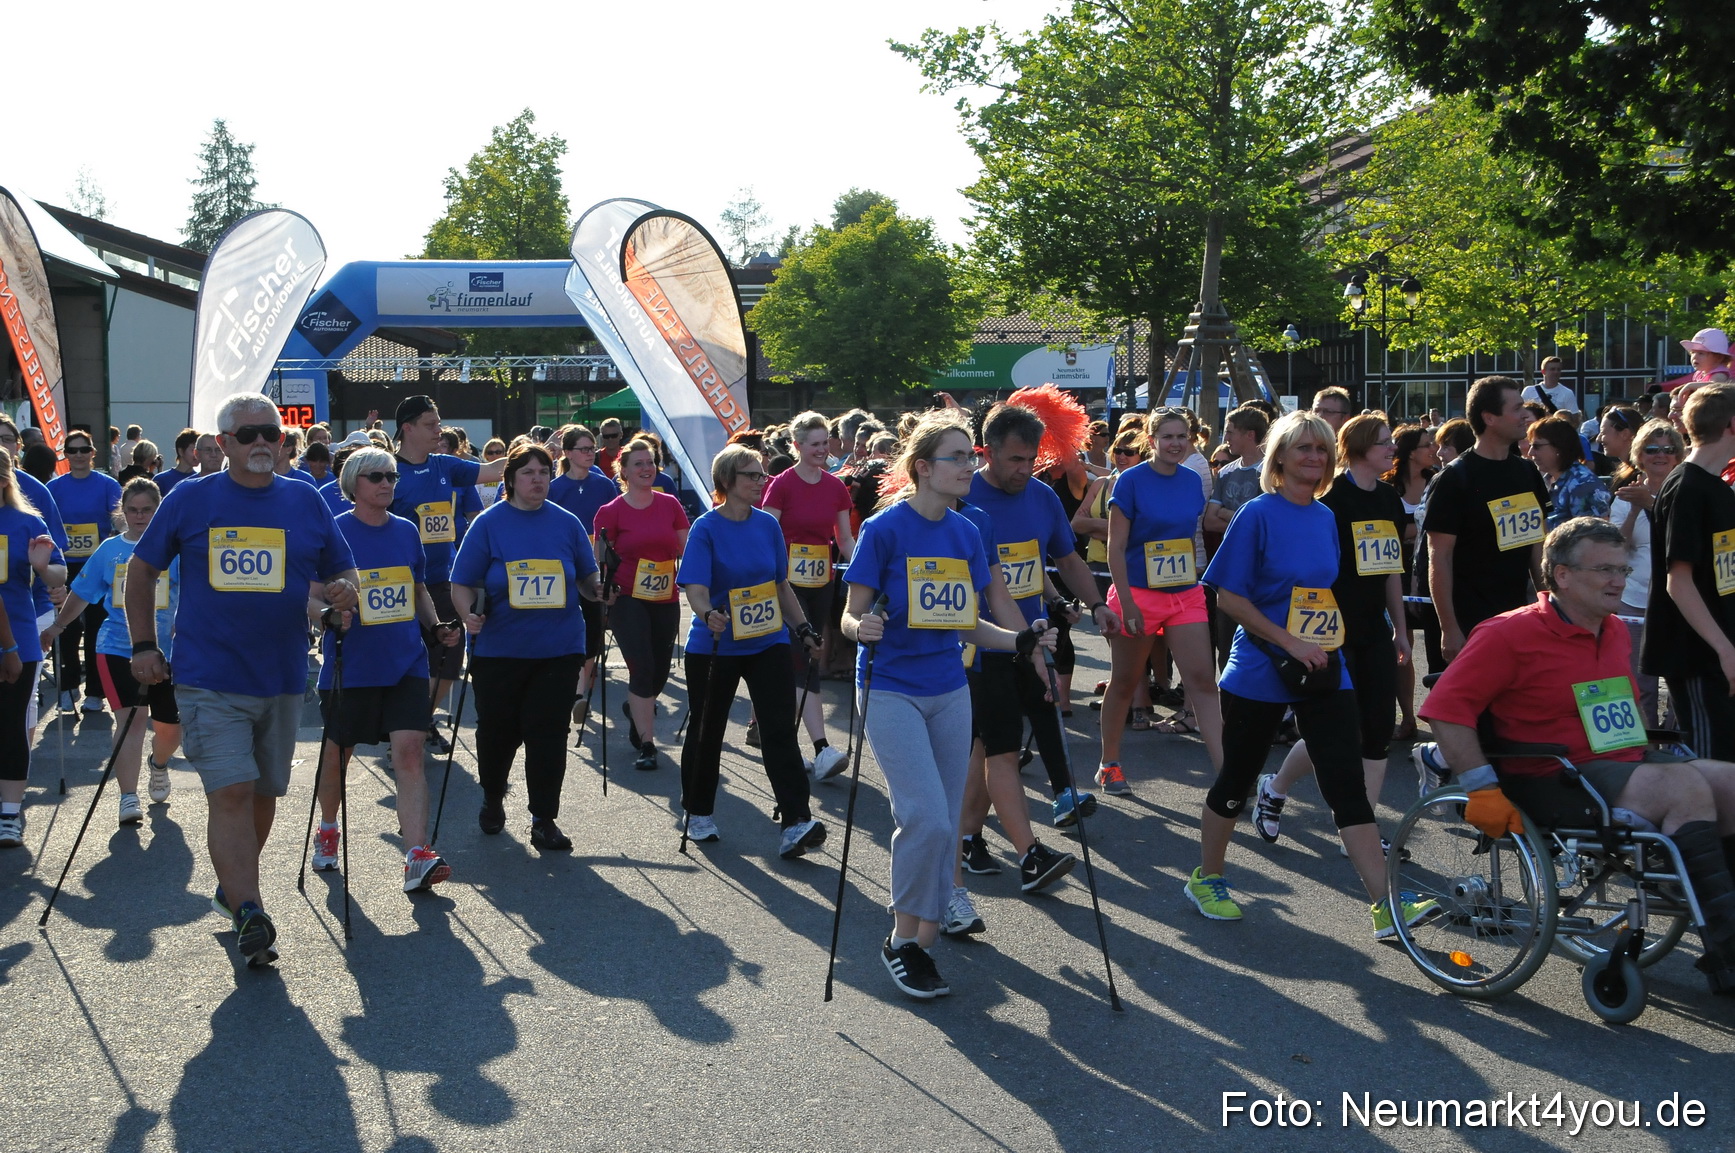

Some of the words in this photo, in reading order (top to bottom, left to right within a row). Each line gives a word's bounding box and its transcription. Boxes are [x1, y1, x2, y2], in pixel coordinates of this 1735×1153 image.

[226, 237, 298, 361] Fischer
[252, 260, 306, 359] AUTOMOBILE
[457, 292, 533, 307] firmenlauf
[310, 318, 351, 327] Fischer
[1052, 372, 1090, 380] Lammsbräu
[425, 516, 449, 533] 682
[1498, 509, 1541, 537] 1135
[220, 549, 273, 576] 660
[1358, 539, 1400, 562] 1149
[794, 559, 825, 577] 418
[1001, 560, 1036, 586] 677
[1153, 555, 1187, 576] 711
[516, 576, 556, 596] 717
[640, 574, 669, 591] 420
[367, 585, 408, 611] 684
[919, 582, 967, 612] 640
[740, 600, 775, 626] 625
[1300, 610, 1339, 636] 724
[1592, 701, 1636, 734] 668
